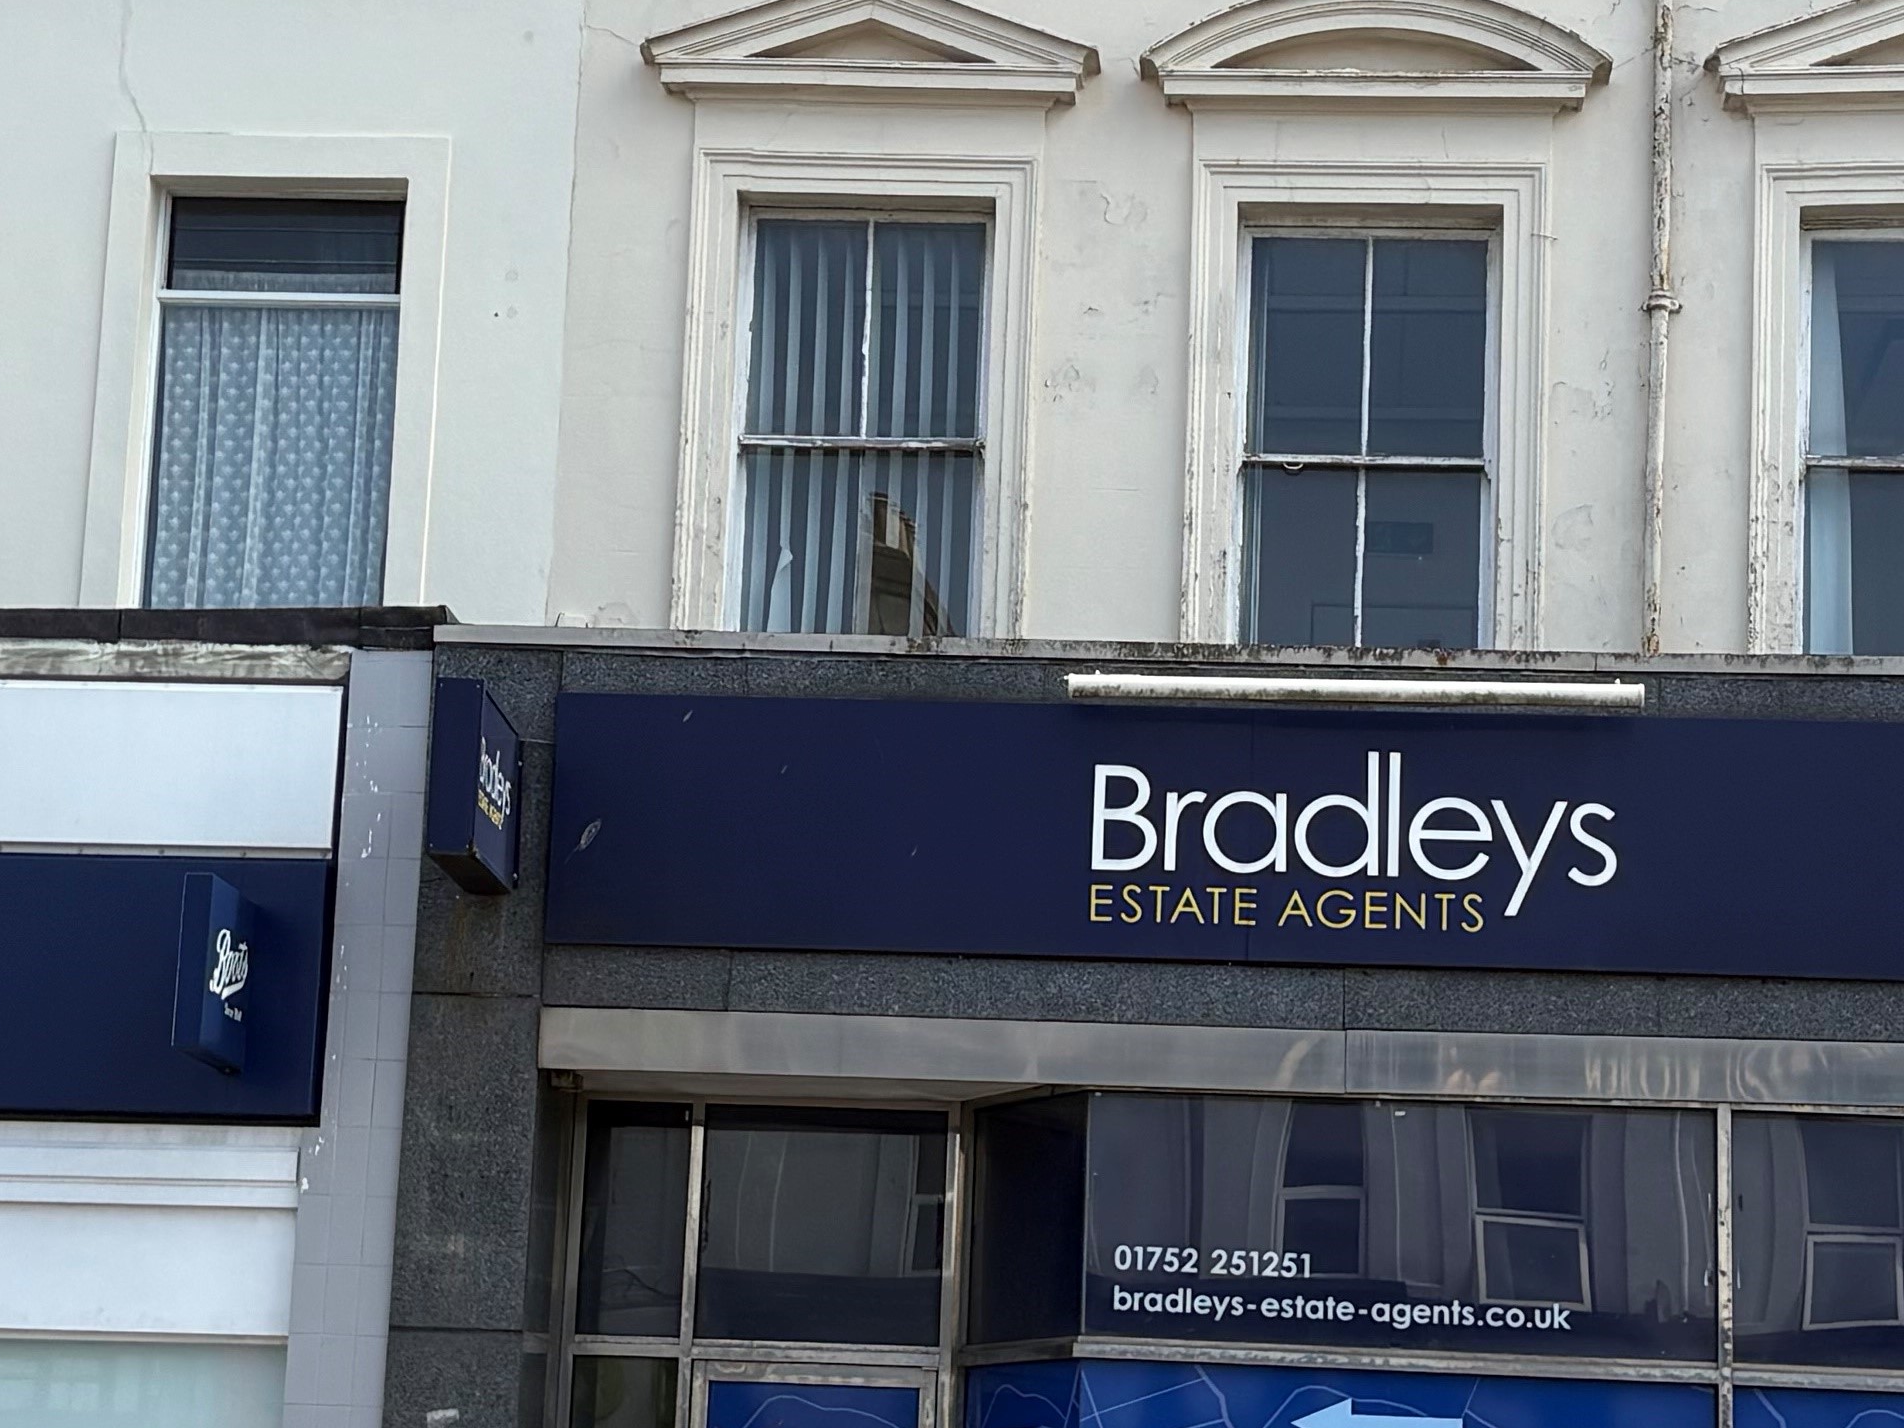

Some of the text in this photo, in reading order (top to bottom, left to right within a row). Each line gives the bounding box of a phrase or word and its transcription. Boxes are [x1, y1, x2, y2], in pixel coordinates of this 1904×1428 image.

[1091, 750, 1619, 917] Bradleys
[1090, 884, 1486, 933] ESTATE AGENTS
[1113, 1244, 1312, 1279] 01752 251251
[1112, 1284, 1572, 1332] bradleys-estate-agents.co.uk
